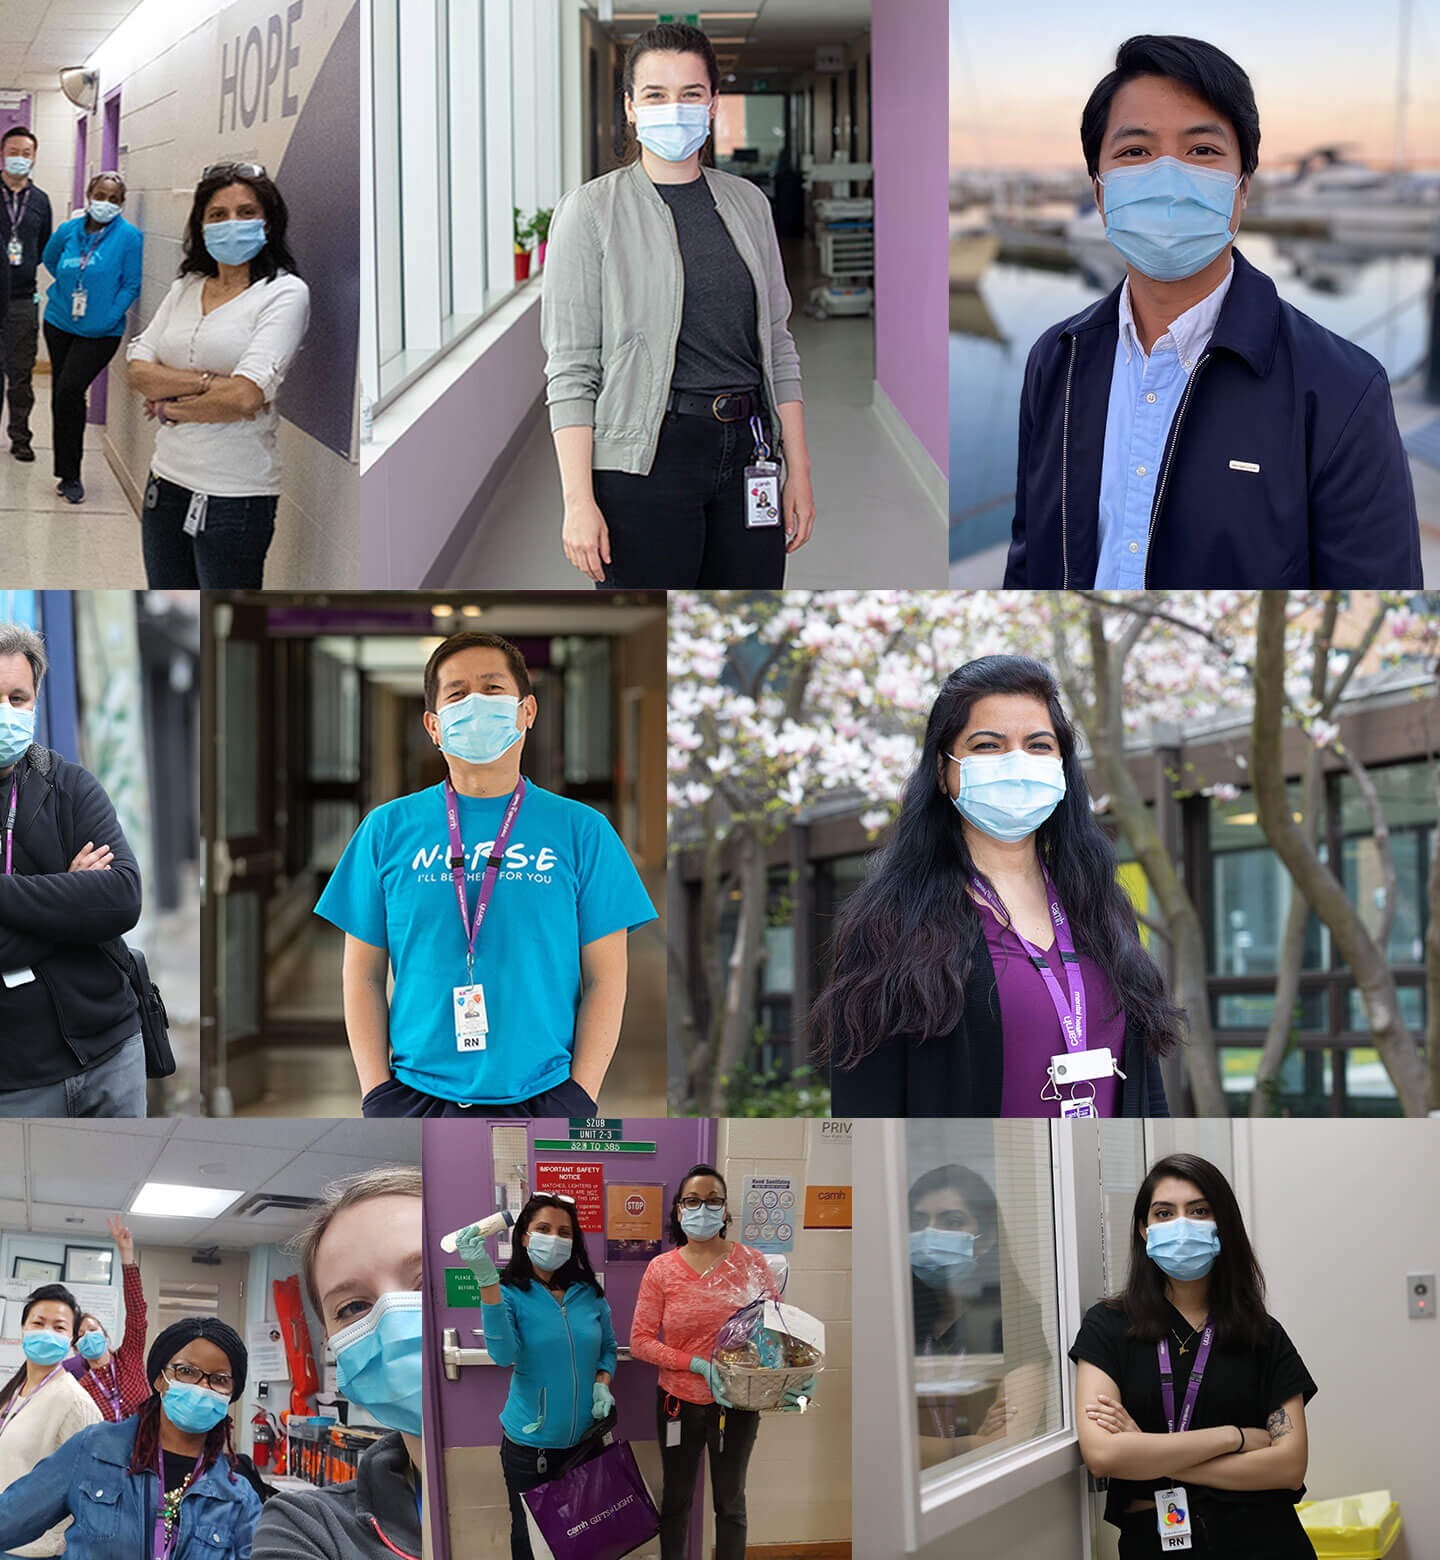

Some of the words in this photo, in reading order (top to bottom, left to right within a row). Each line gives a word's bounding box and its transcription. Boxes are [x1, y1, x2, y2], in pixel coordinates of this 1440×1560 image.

[218, 0, 303, 134] HOPE
[499, 872, 523, 881] FOR
[526, 873, 552, 884] YOU
[1051, 902, 1065, 926] camh
[1063, 1015, 1079, 1047] camh
[464, 1038, 479, 1047] RN
[822, 1121, 852, 1134] PRIV
[580, 1130, 596, 1139] UNIT
[599, 1130, 612, 1139] 2-3
[590, 1142, 601, 1151] TO
[818, 1190, 846, 1200] camh
[627, 1201, 644, 1210] STOP
[566, 1520, 588, 1537] camh
[590, 1509, 611, 1525] GIFTS
[614, 1494, 634, 1511] LIGHT
[1169, 1536, 1185, 1547] RN
